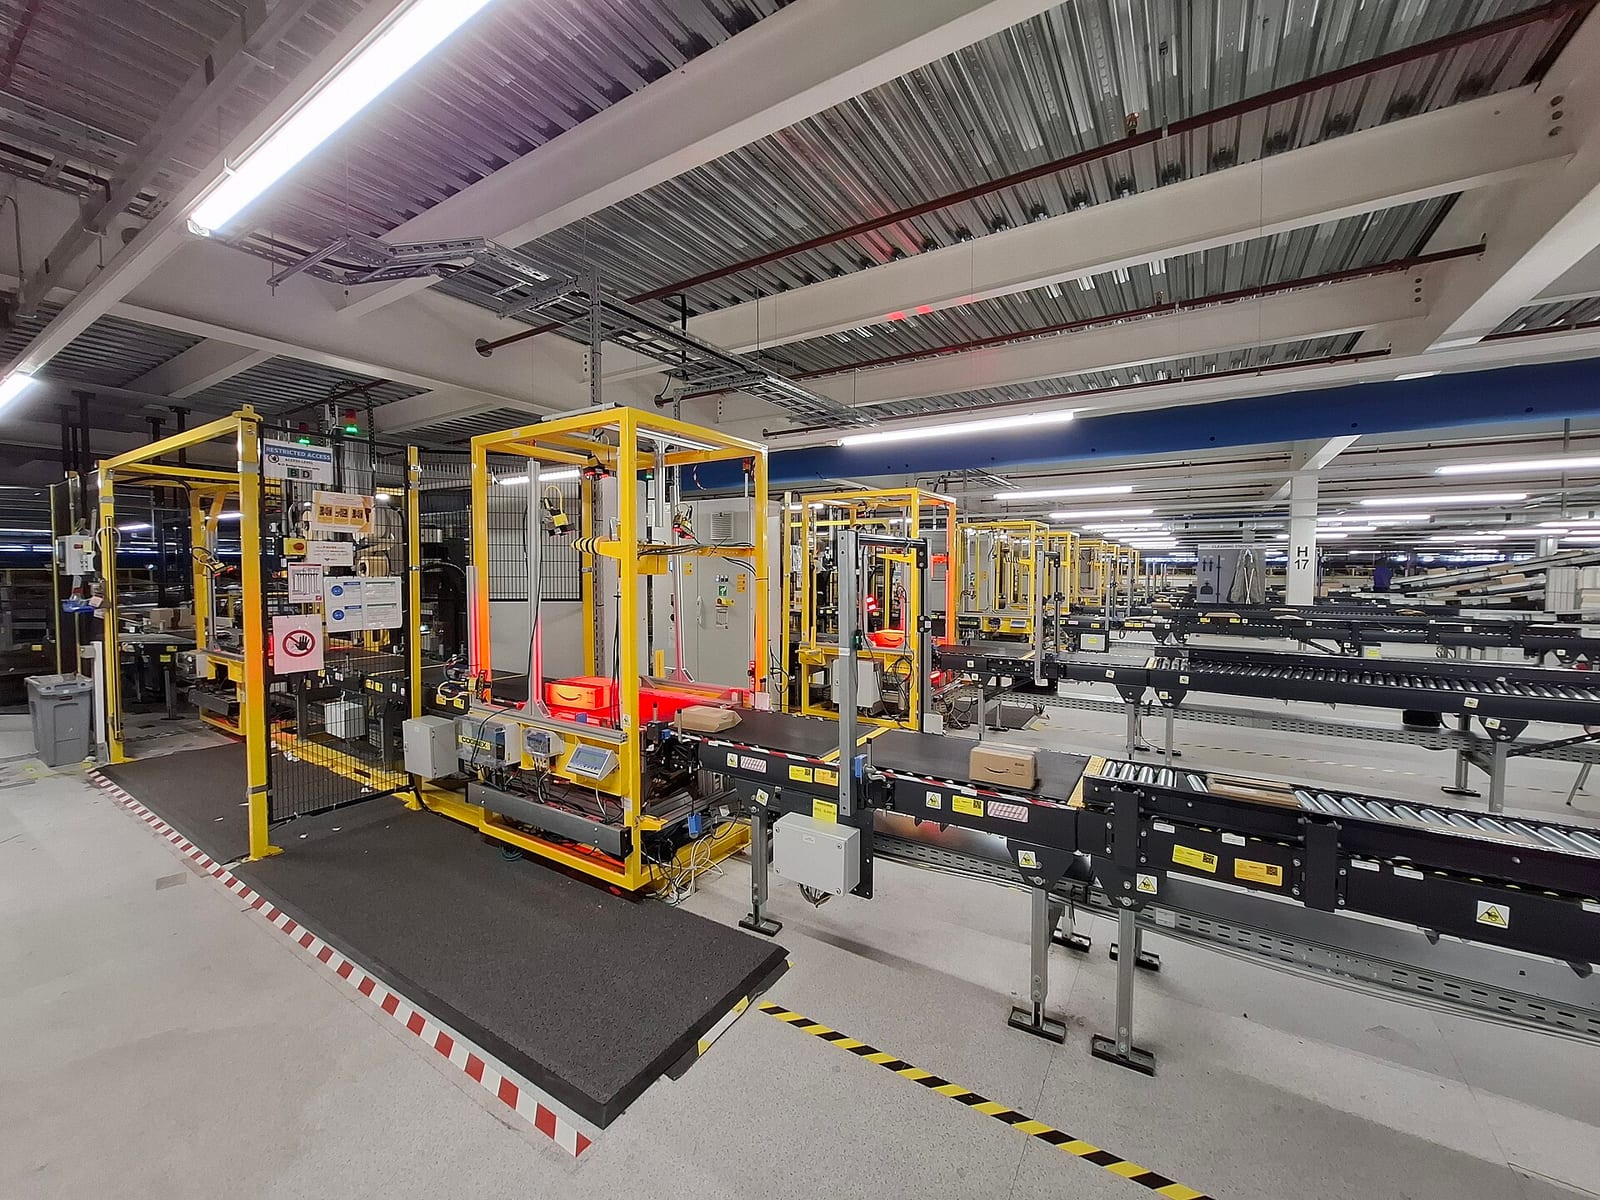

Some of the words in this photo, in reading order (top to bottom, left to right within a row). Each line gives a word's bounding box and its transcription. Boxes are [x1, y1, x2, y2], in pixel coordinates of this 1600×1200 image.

[265, 446, 306, 456] RESTRICTED
[307, 452, 331, 460] ACCESS
[290, 469, 298, 477] B
[302, 470, 310, 479] D
[1297, 545, 1308, 558] H
[1294, 558, 1310, 570] 17
